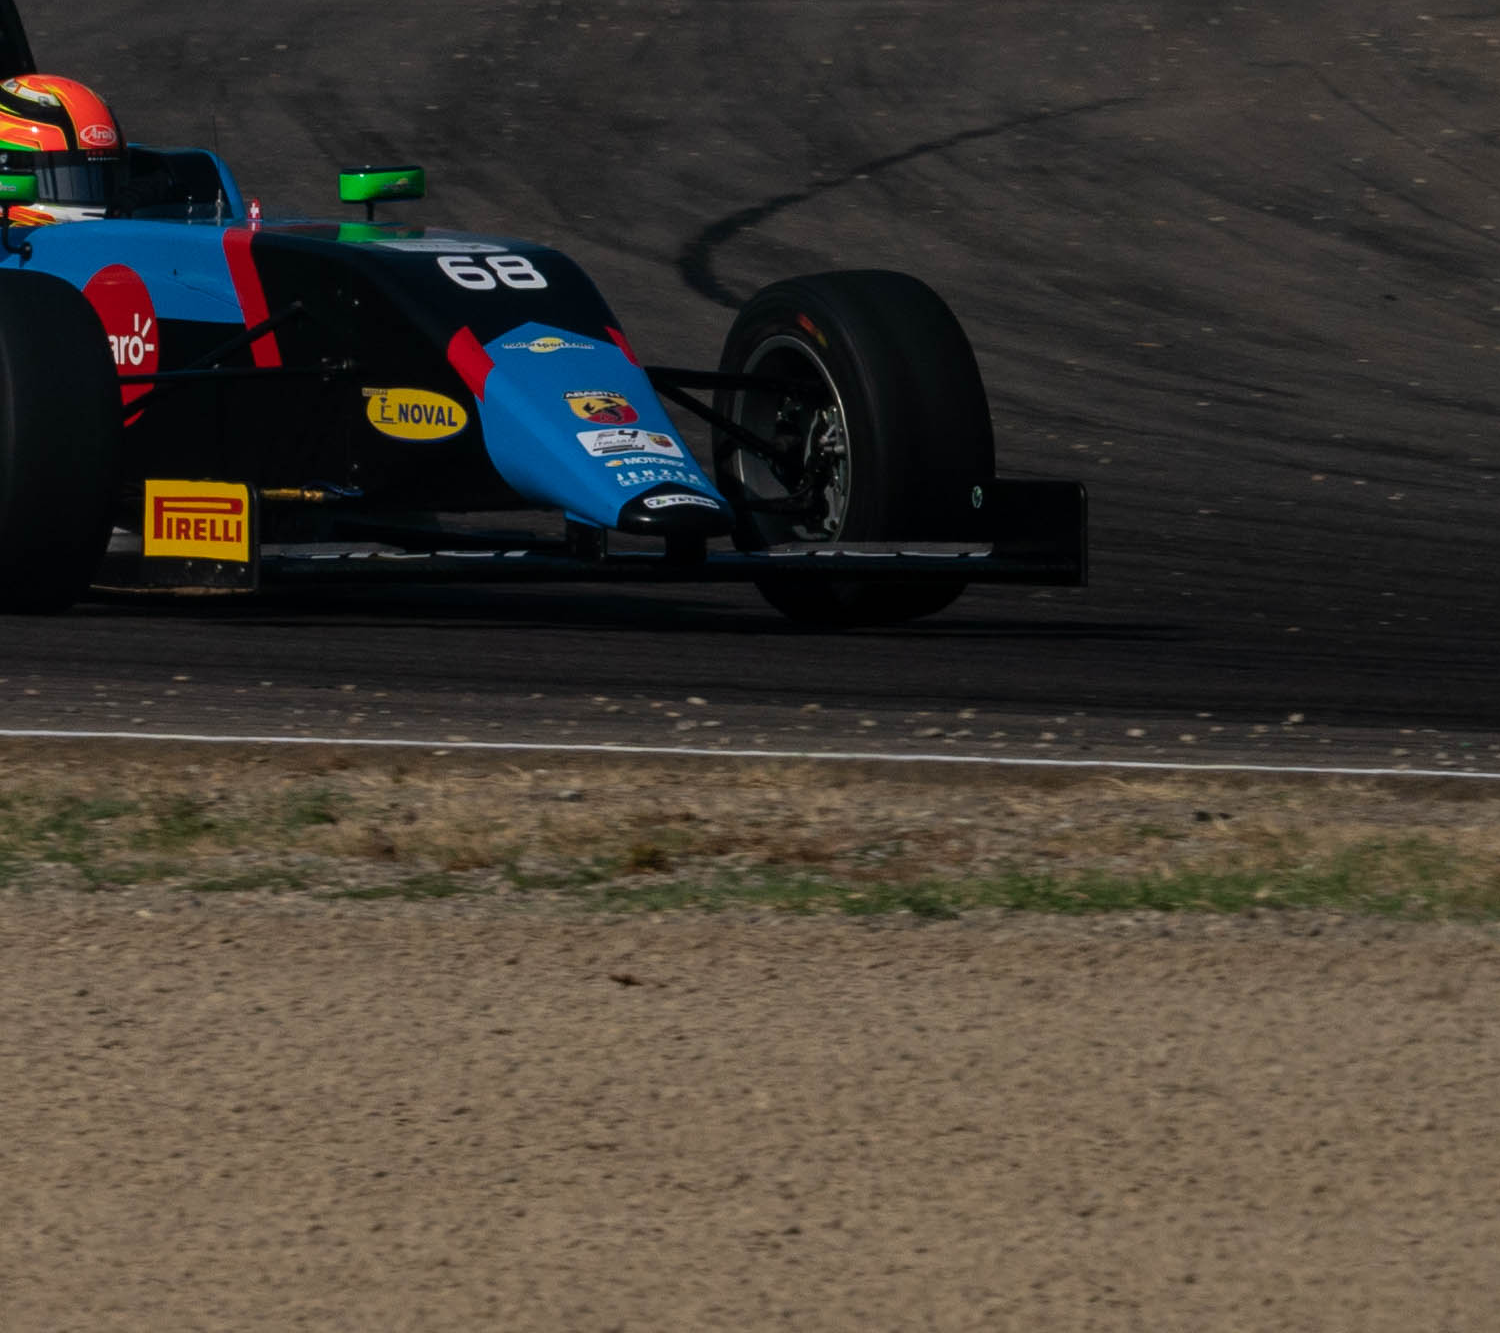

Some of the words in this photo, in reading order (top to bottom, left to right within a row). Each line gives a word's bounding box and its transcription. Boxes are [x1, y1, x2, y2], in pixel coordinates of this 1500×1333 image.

[436, 255, 548, 290] 68
[398, 403, 458, 427] NOVAL
[154, 496, 243, 543] PIRELLI
